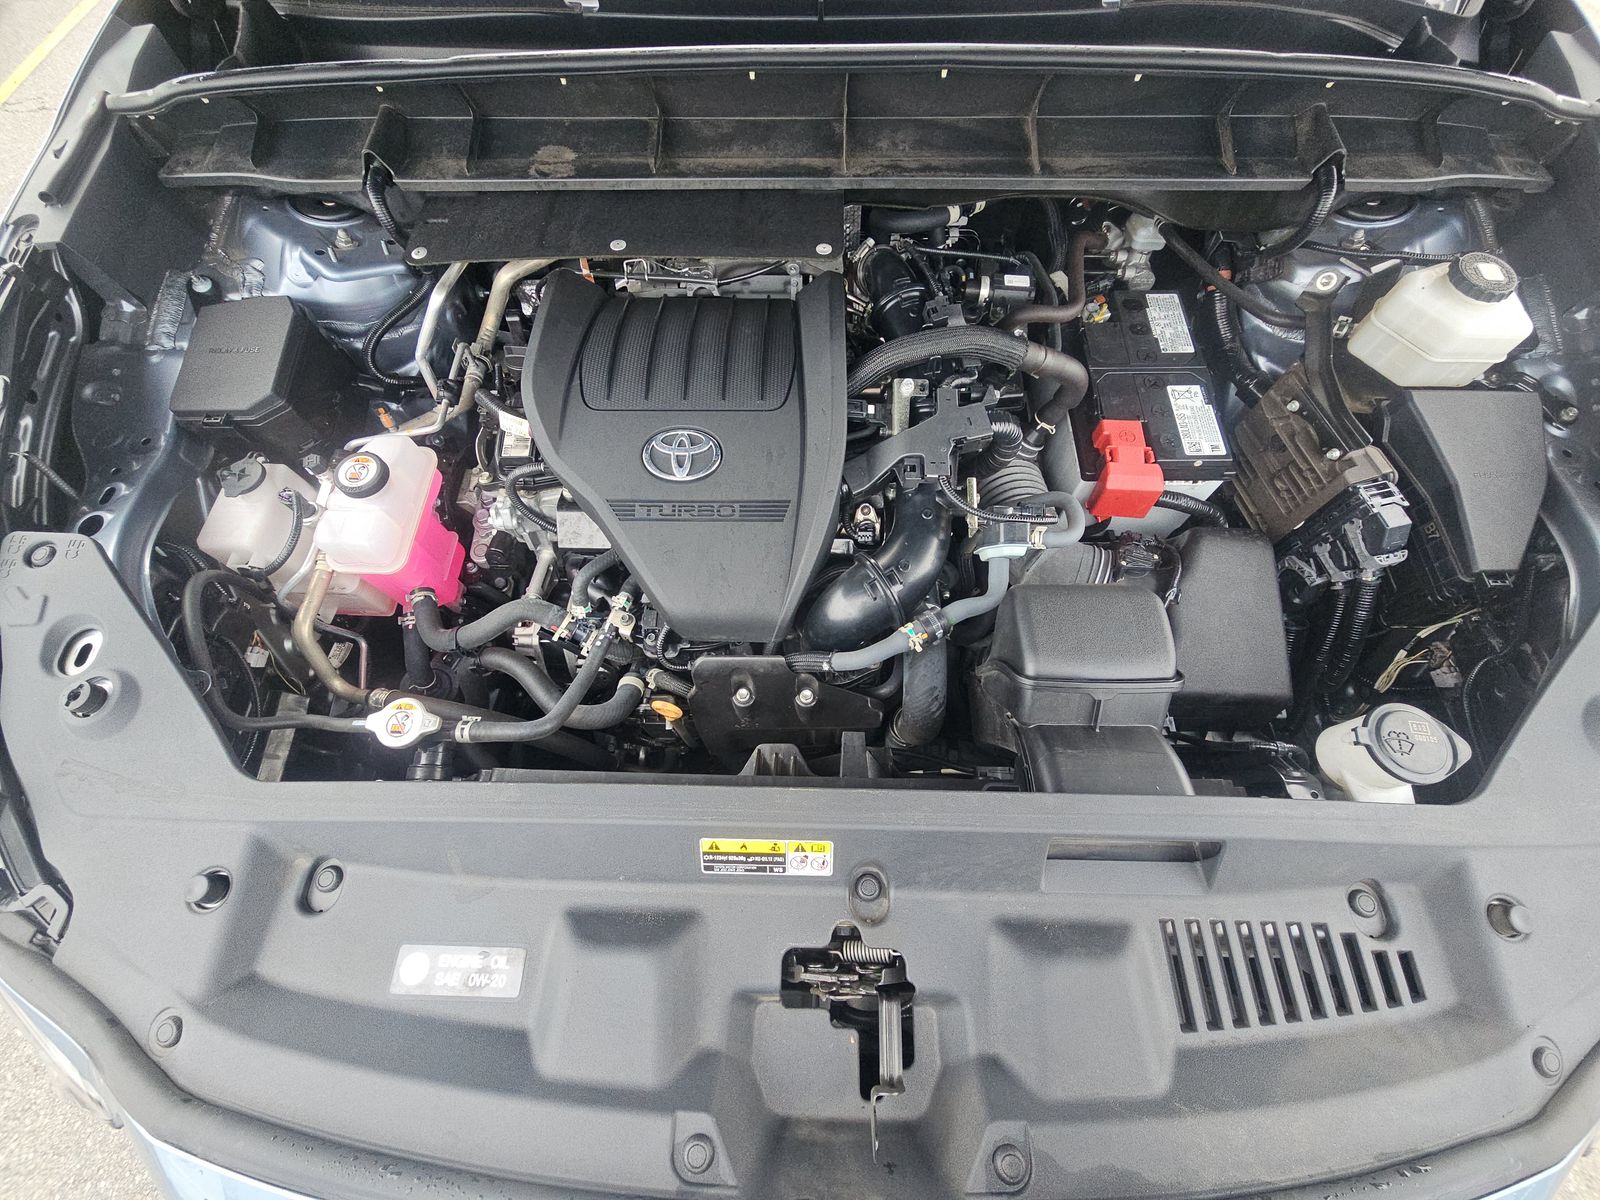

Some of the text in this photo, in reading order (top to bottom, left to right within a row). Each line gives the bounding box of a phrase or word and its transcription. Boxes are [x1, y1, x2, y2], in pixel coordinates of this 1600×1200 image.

[638, 504, 736, 518] TURBO
[438, 953, 511, 970] ENGINE OIL
[434, 971, 508, 989] SAE 0W-20
